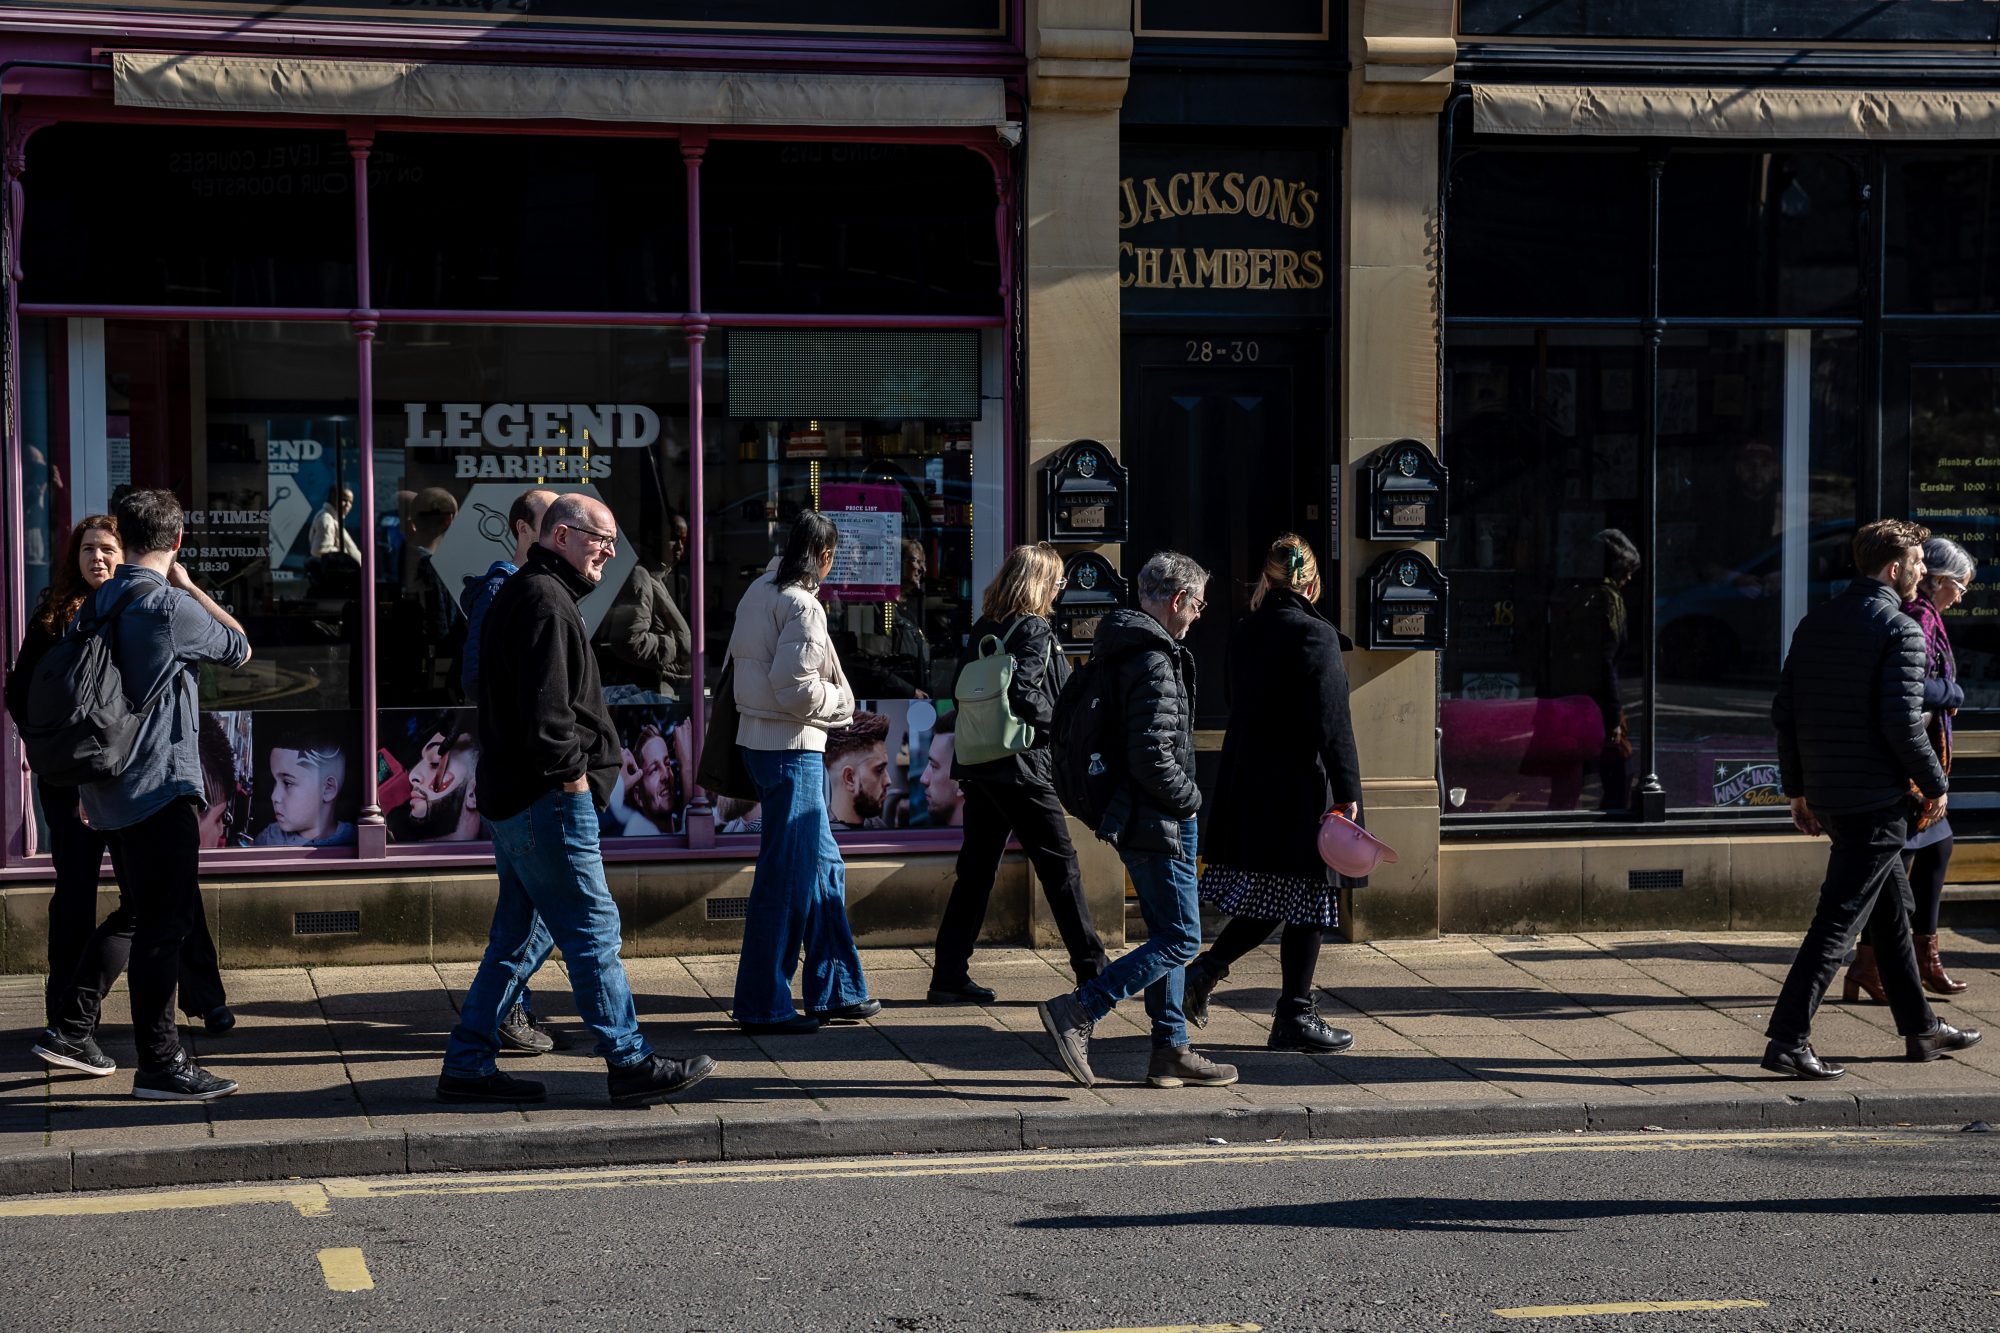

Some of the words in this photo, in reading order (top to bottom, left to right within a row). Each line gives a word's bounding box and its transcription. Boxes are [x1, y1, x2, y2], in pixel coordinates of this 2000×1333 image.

[1119, 172, 1319, 229] JACKSON'S
[1119, 241, 1324, 289] CHAMBERS
[1186, 341, 1259, 362] 28-30
[404, 403, 660, 448] LEGEND
[455, 455, 612, 479] BARBERS
[1920, 482, 1956, 492] Tuesday:
[1963, 482, 1986, 492] 10:00
[209, 510, 271, 524] TIMES
[1966, 507, 1989, 517] 10:00
[1963, 532, 1985, 541] 10:00
[200, 547, 273, 558] SATURDAY
[199, 562, 230, 572] 18:30
[1494, 599, 1515, 625] 18
[1972, 606, 1999, 616] Closed
[1714, 768, 1774, 805] WALK-INS
